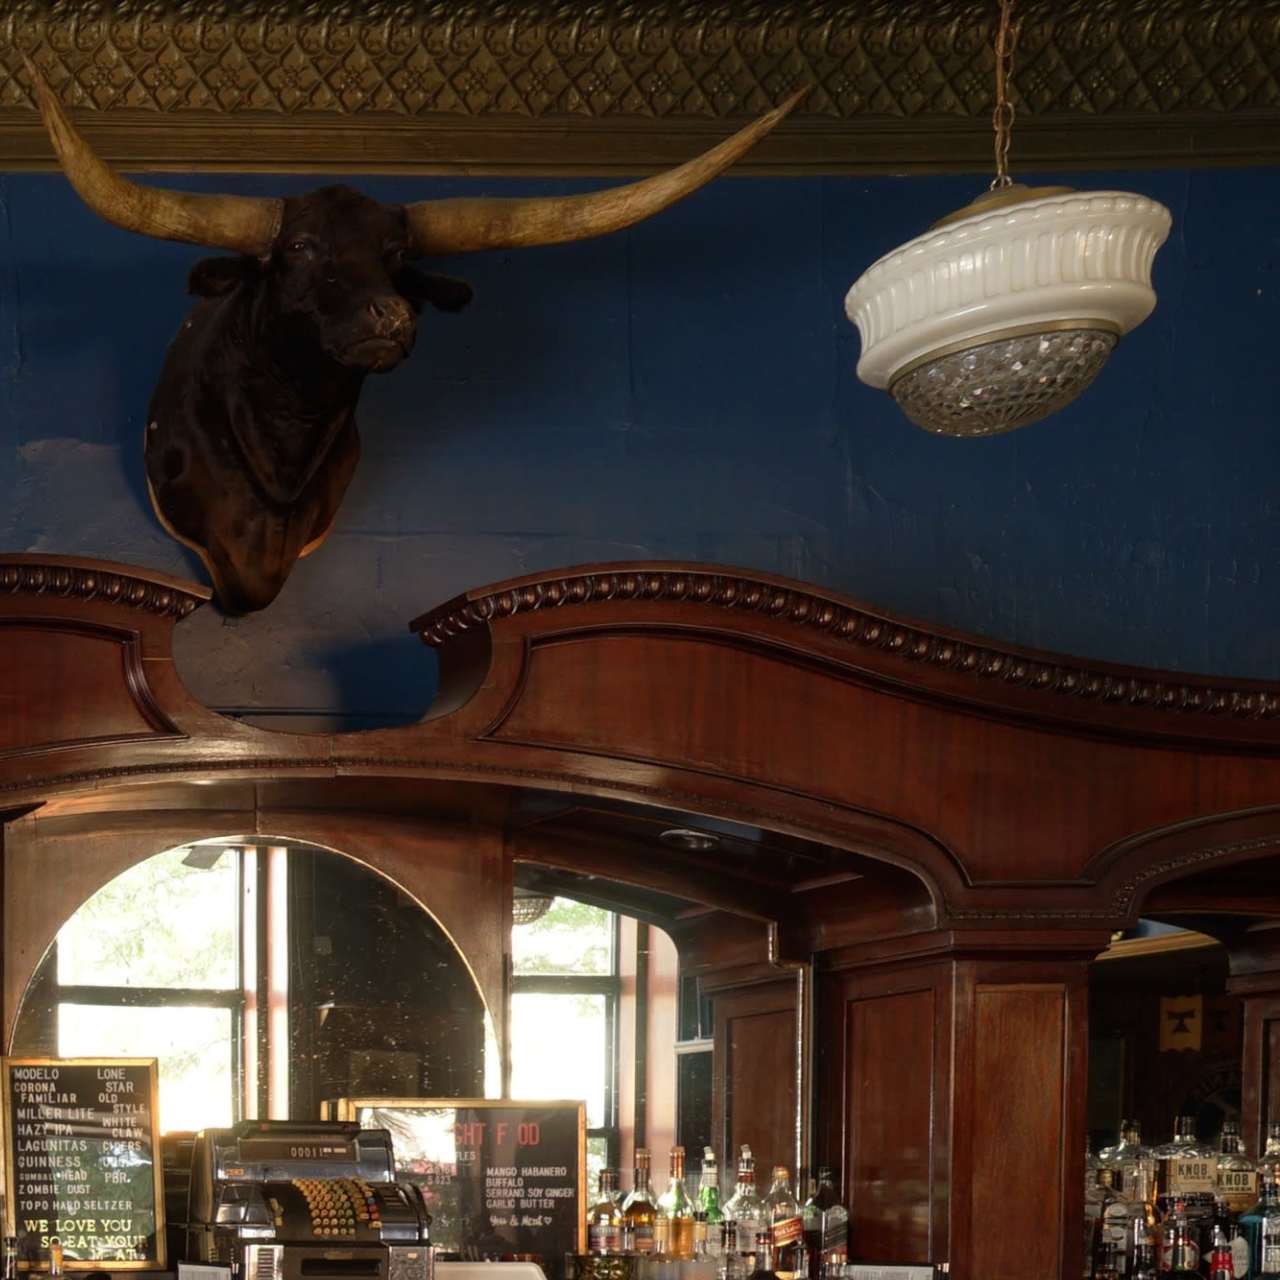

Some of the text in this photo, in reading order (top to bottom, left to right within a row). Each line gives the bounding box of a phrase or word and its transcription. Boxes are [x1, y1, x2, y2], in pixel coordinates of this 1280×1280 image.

[14, 1068, 60, 1080] MODELO
[97, 1068, 126, 1080] LONE
[14, 1082, 56, 1093] CORONA
[105, 1081, 134, 1093] STAR
[21, 1093, 77, 1104] FAMILIAR
[98, 1093, 118, 1103] OLD
[17, 1108, 95, 1120] MILLER LITE
[113, 1104, 145, 1114] STYLE
[102, 1117, 137, 1127] WHITE
[17, 1123, 73, 1135] HAZY IPA
[112, 1128, 143, 1138] CLAW
[18, 1140, 87, 1152] LAGUNITAS
[18, 1156, 81, 1168] GUINNESS
[486, 1166, 567, 1177] MANGO HABANERO
[1178, 1163, 1208, 1176] KNOB
[61, 1170, 87, 1181] HEAD
[1217, 1173, 1249, 1186] KNOB
[486, 1177, 524, 1187] BUFFALO
[19, 1184, 90, 1195] ZOMBIE DUST
[486, 1188, 575, 1198] SERRANO SOY GINGER
[20, 1200, 132, 1211] TOPO HARD SELTZER
[486, 1199, 555, 1209] GARLIC BUTTER
[24, 1219, 132, 1232] WE LOVE YOU
[67, 1236, 97, 1248] EAT
